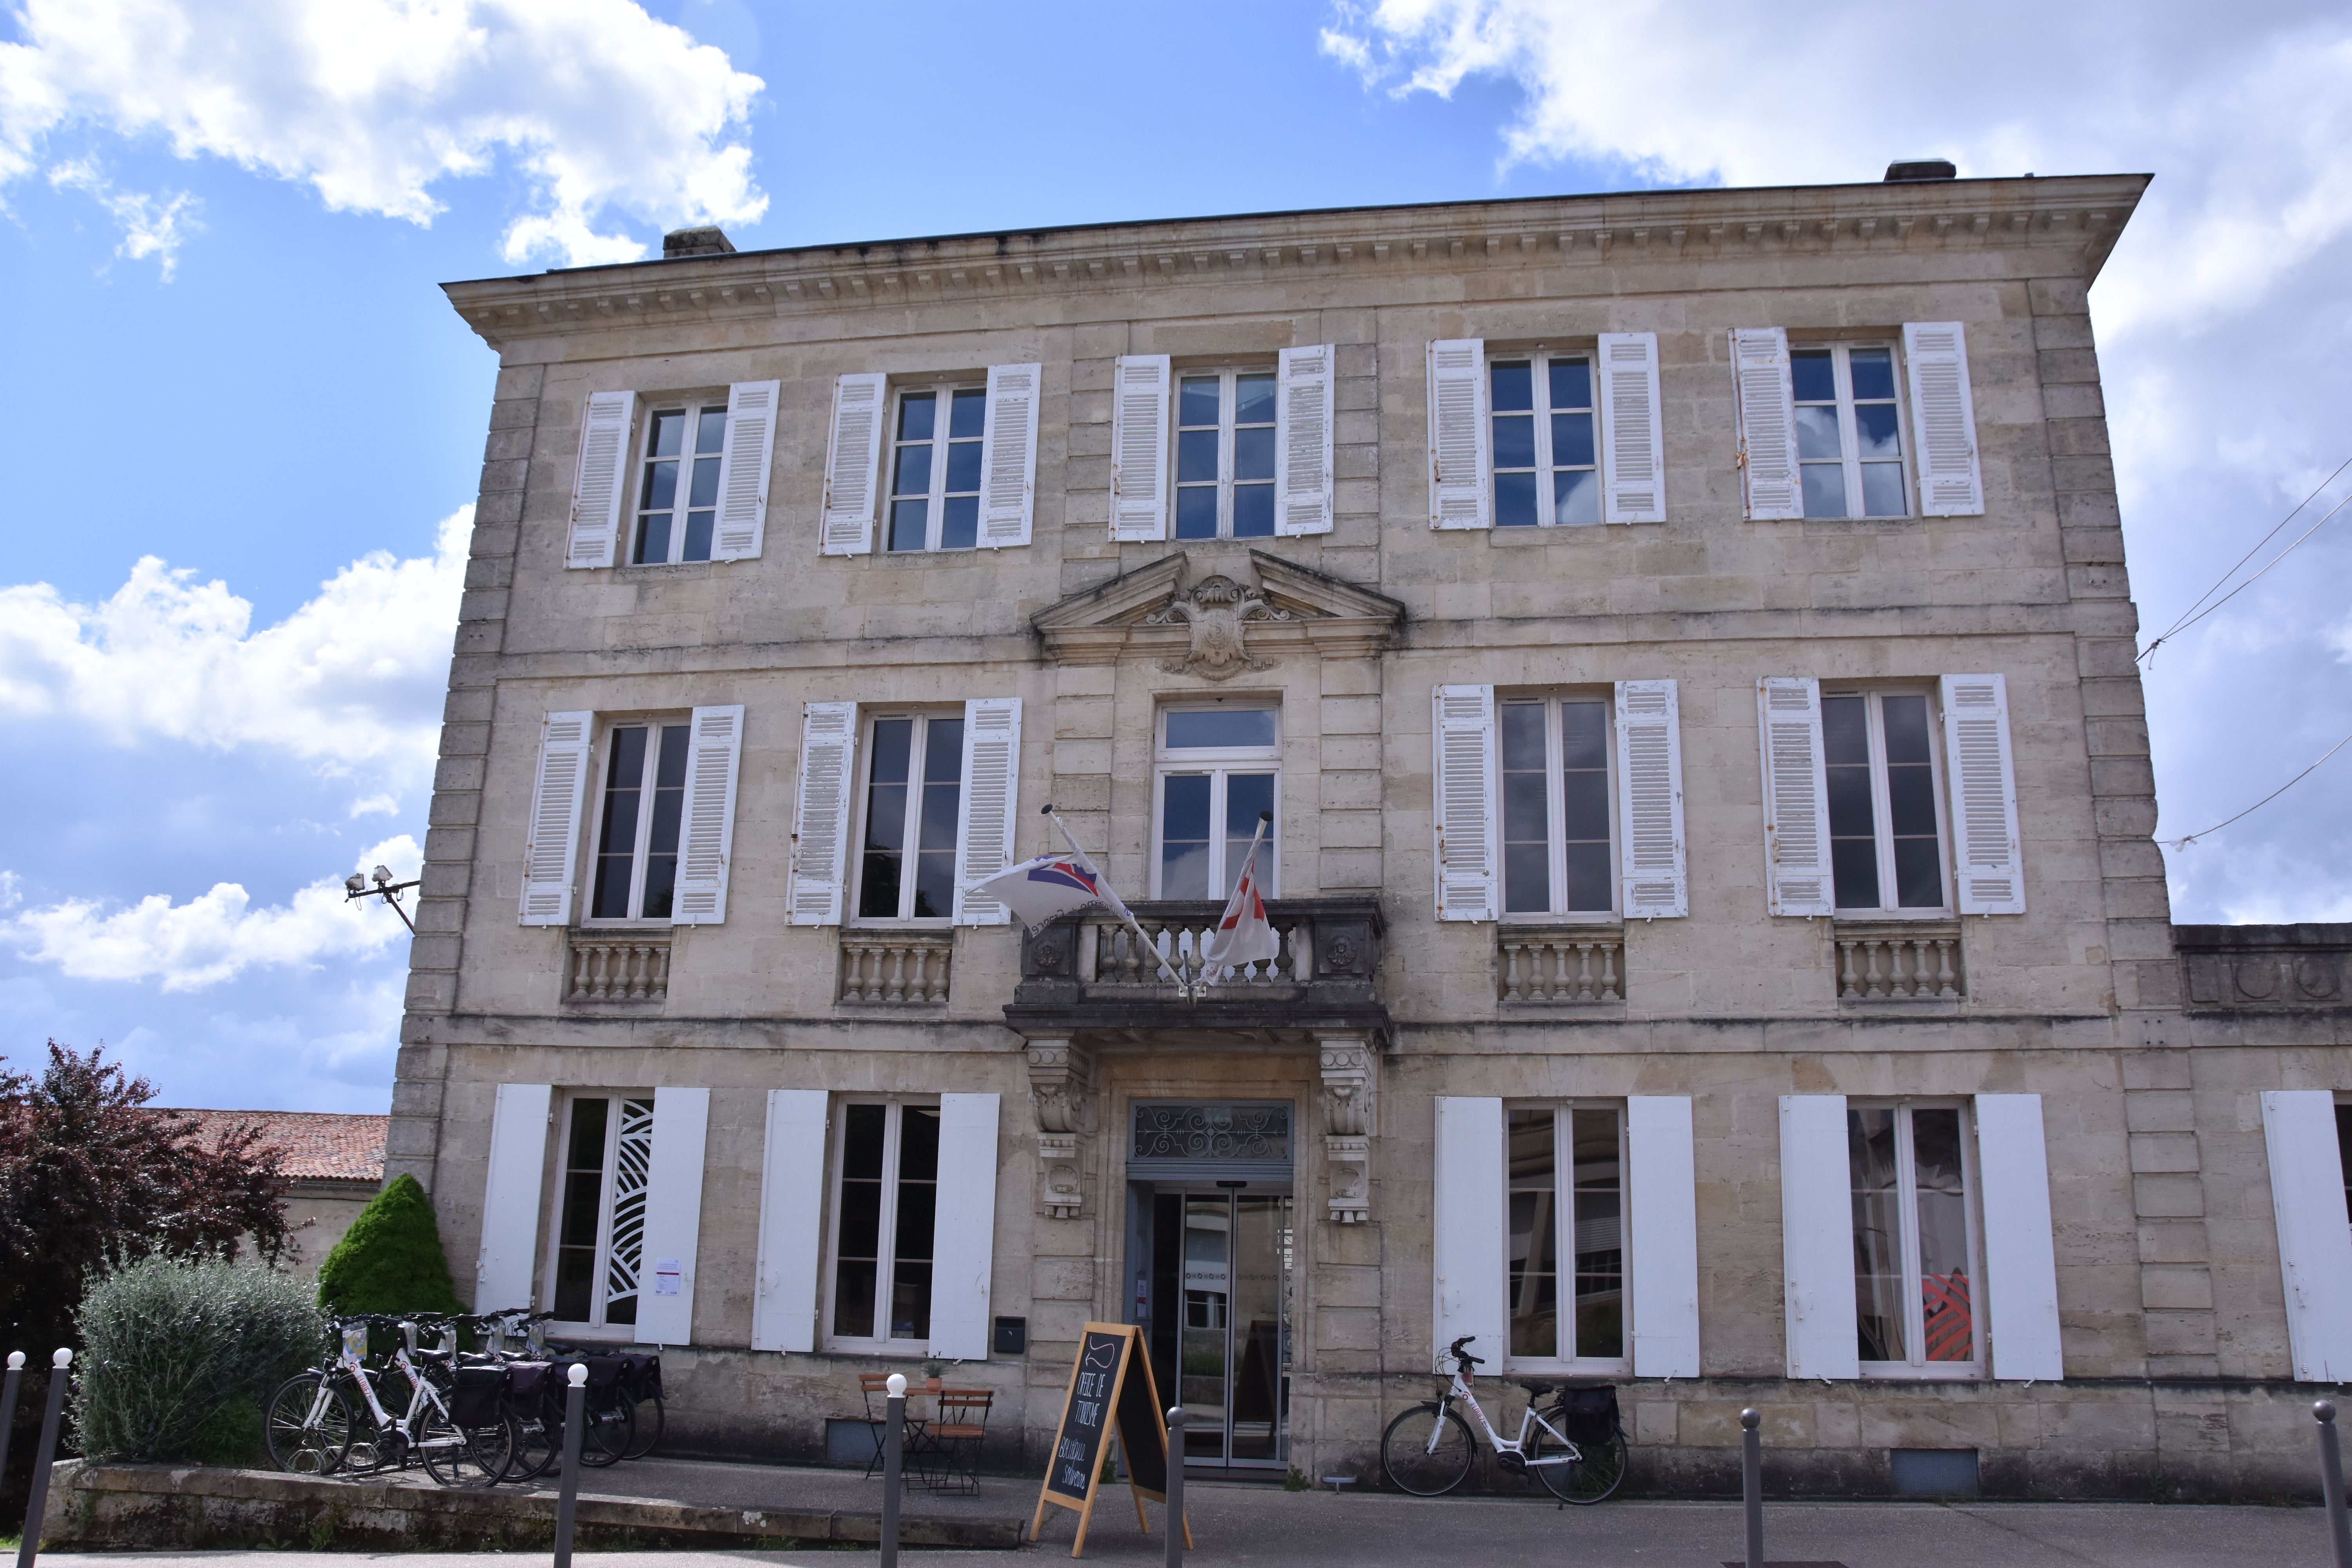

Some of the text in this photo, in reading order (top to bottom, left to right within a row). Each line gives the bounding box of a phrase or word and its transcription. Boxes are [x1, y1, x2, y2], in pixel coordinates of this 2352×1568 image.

[358, 1377, 372, 1396] LOUEZ
[409, 1375, 419, 1389] LOU
[1077, 1372, 1106, 1397] OFFICE DE
[1075, 1400, 1100, 1427] TOURISME
[1472, 1405, 1485, 1422] LOUEZ
[1058, 1436, 1085, 1468] Boutique
